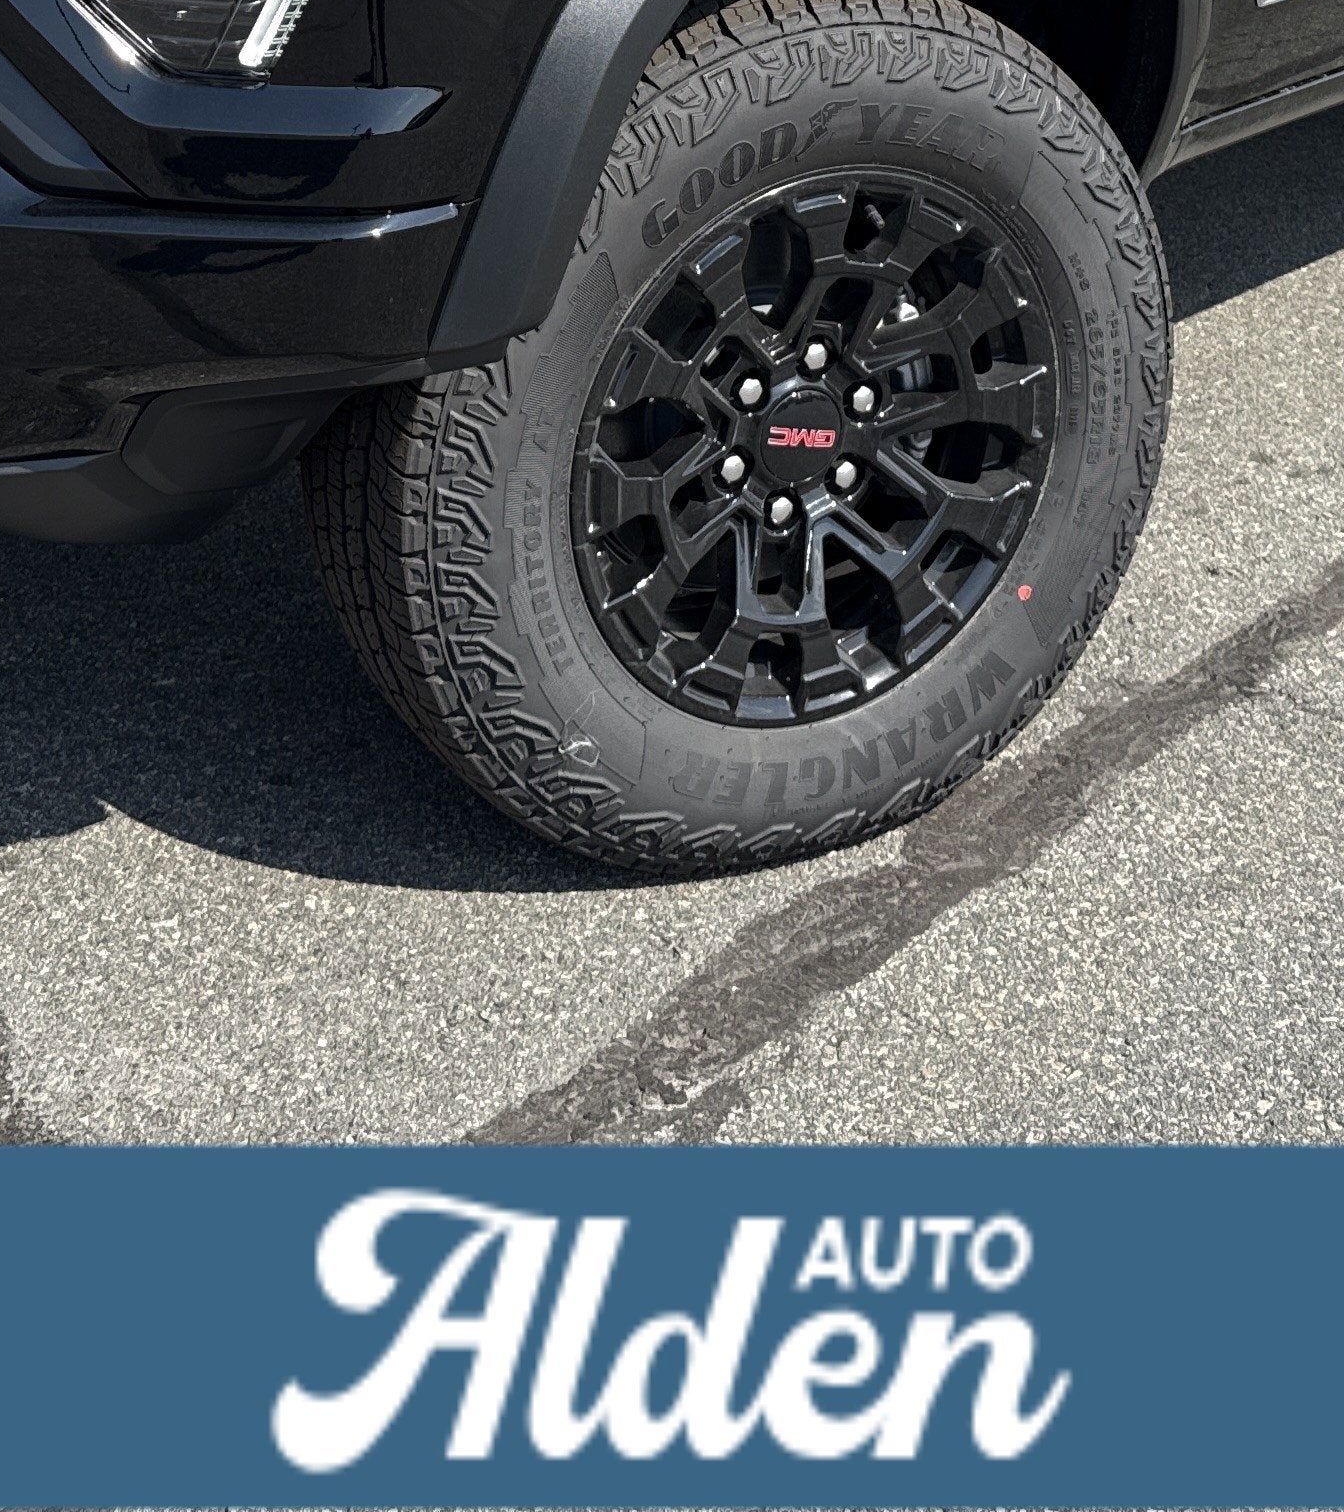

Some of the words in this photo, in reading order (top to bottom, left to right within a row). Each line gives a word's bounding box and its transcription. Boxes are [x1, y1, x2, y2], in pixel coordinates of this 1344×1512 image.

[641, 120, 799, 249] GOOD
[855, 101, 1007, 173] YEAR
[767, 426, 836, 448] GMC
[670, 650, 1017, 806] WRANGLER
